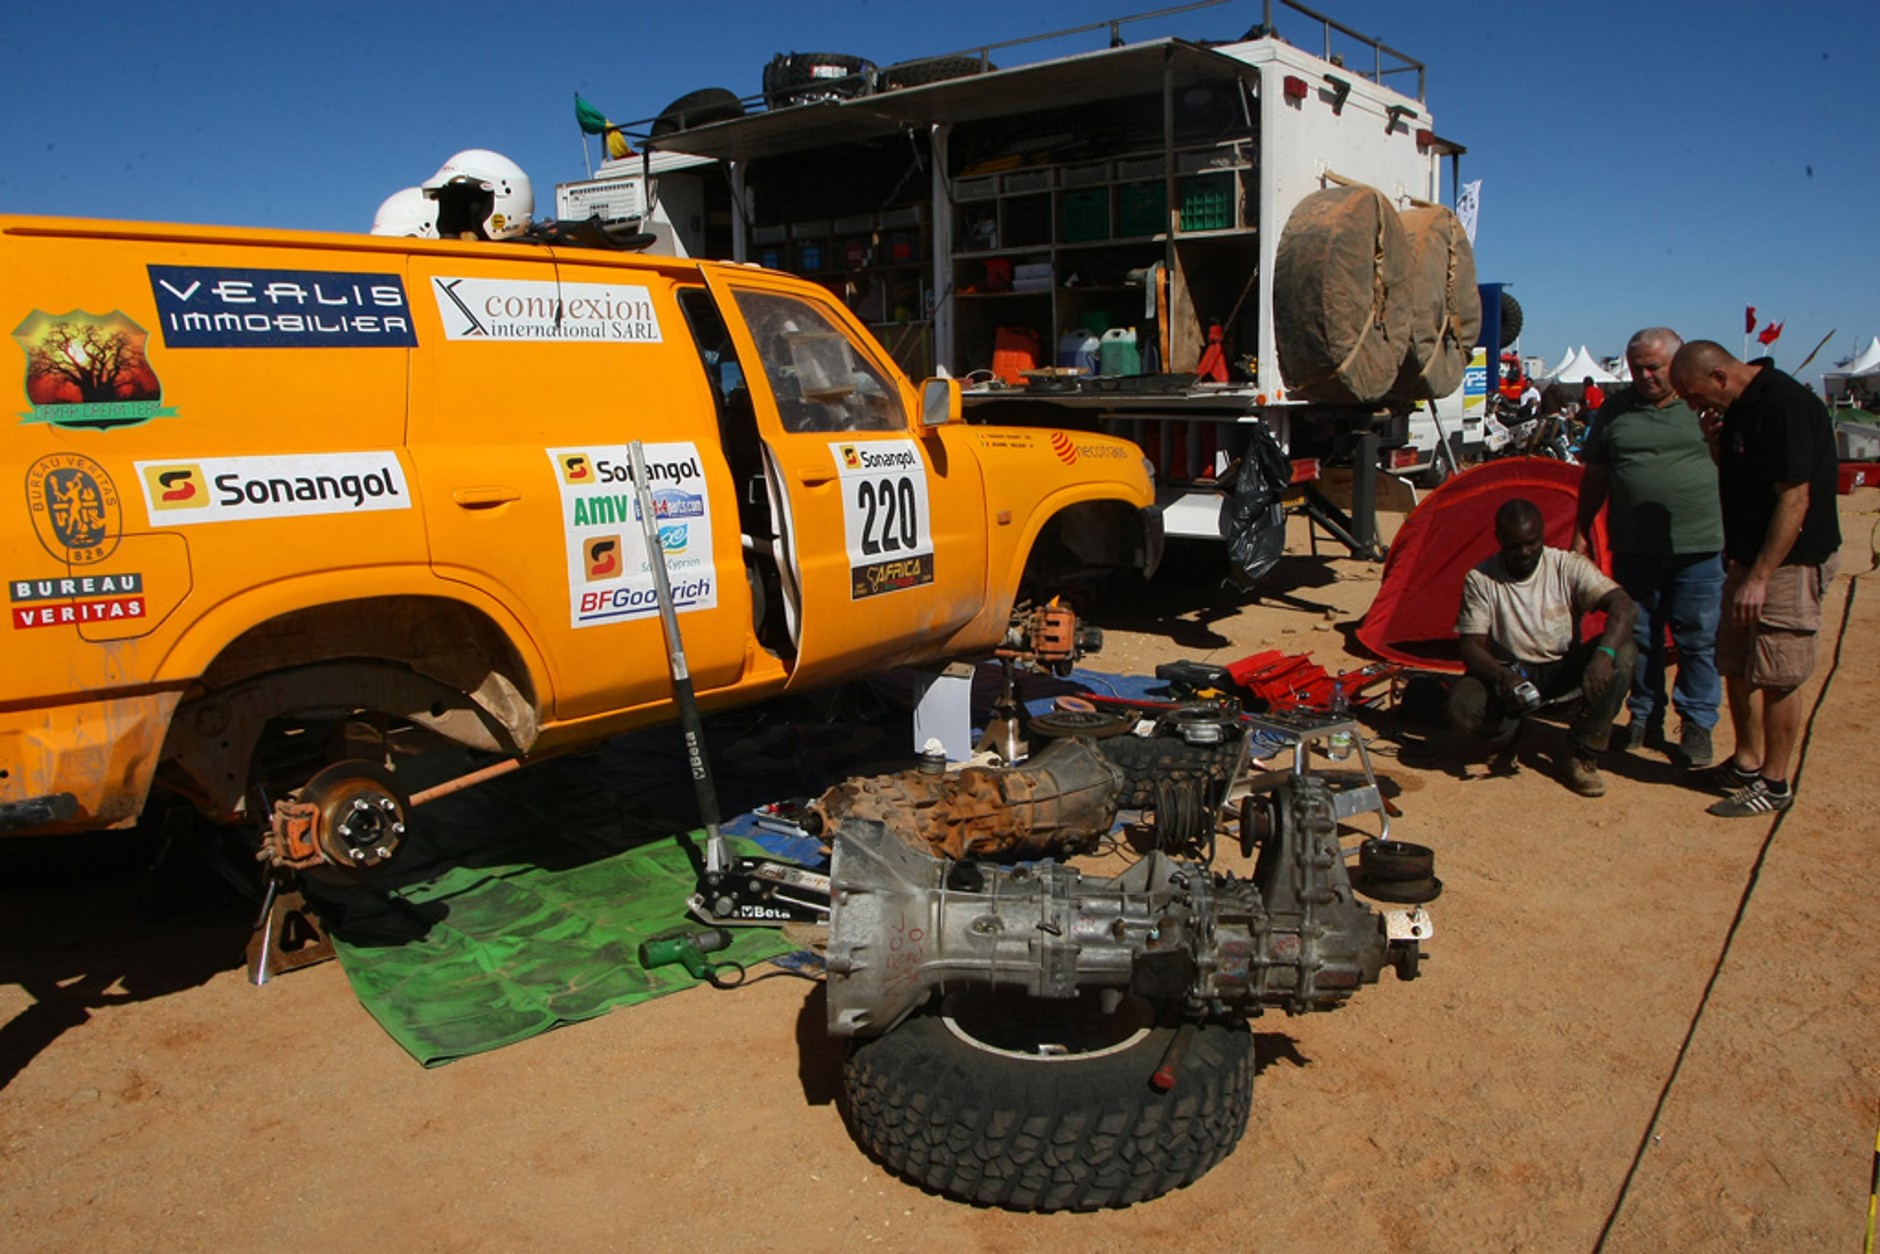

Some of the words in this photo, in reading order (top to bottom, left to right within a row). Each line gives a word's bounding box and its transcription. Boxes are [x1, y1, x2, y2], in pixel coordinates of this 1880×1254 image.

[484, 293, 652, 322] connexion
[170, 311, 408, 334] IMMOBILIER
[491, 320, 606, 338] international
[611, 322, 658, 339] SARL
[596, 457, 701, 485] Soangol
[860, 448, 916, 469] Sonangol
[30, 458, 60, 512] BUREAU
[66, 457, 117, 506] VERITAS
[215, 466, 399, 506] Sonangol
[858, 476, 918, 555] 220
[74, 547, 104, 560] 828
[876, 559, 922, 584] AFRICA
[16, 576, 135, 598] BUREAU
[580, 579, 710, 612] BFGoorich
[20, 601, 141, 626] VERITAS
[685, 731, 703, 772] Beta
[754, 905, 791, 919] Beta
